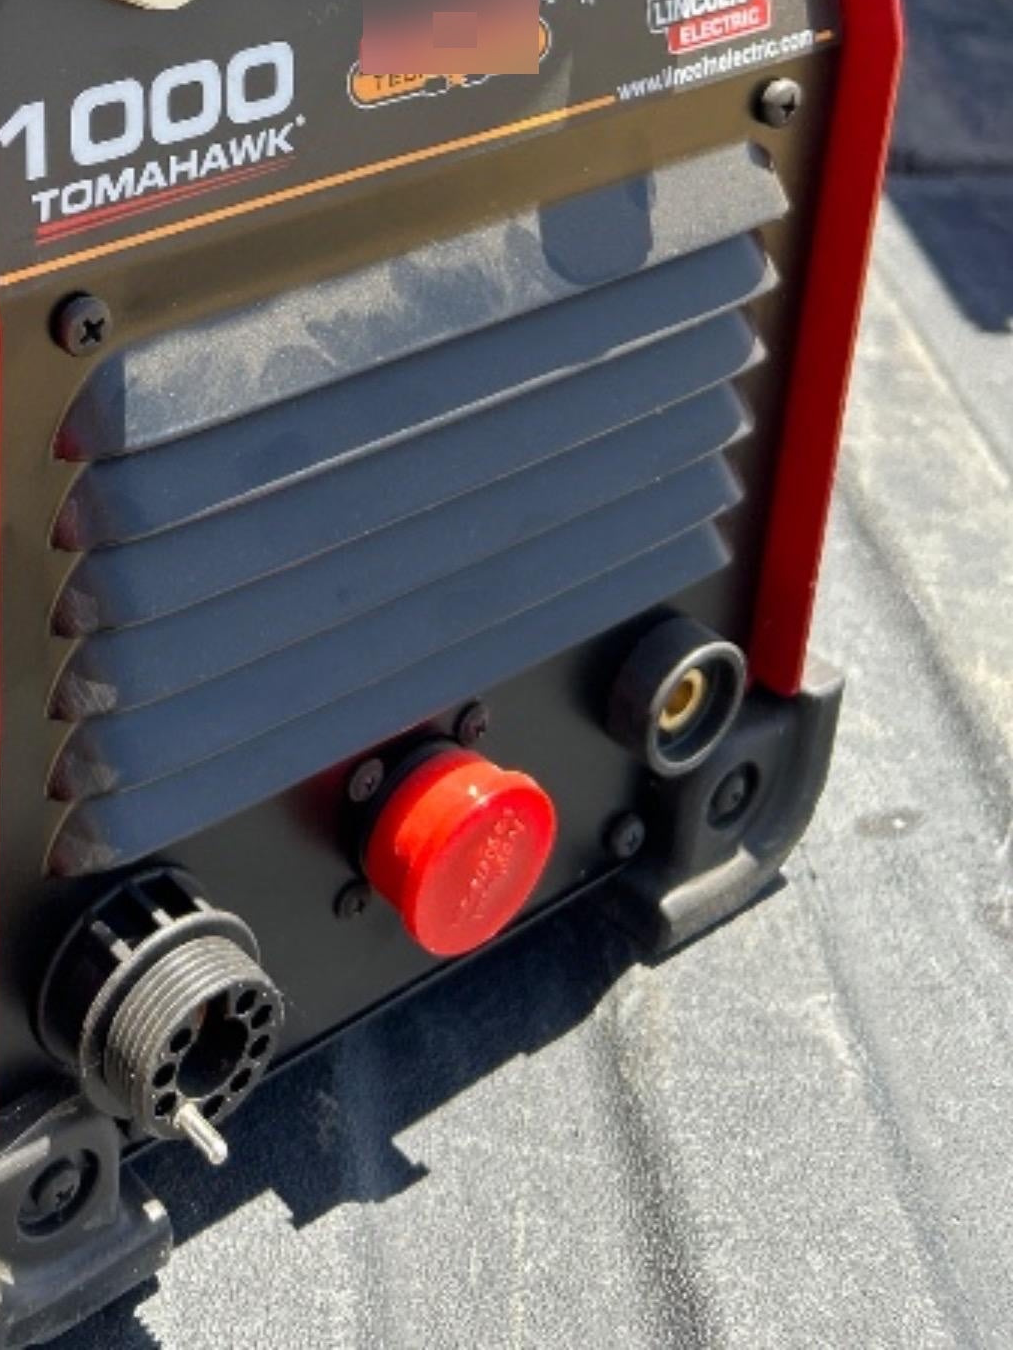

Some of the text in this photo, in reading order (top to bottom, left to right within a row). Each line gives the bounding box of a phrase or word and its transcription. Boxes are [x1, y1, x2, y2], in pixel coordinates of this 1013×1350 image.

[679, 6, 760, 47] ELECTRIC
[616, 28, 815, 101] www.lincolnelectric.com
[31, 122, 295, 223] TOMAHAWK
